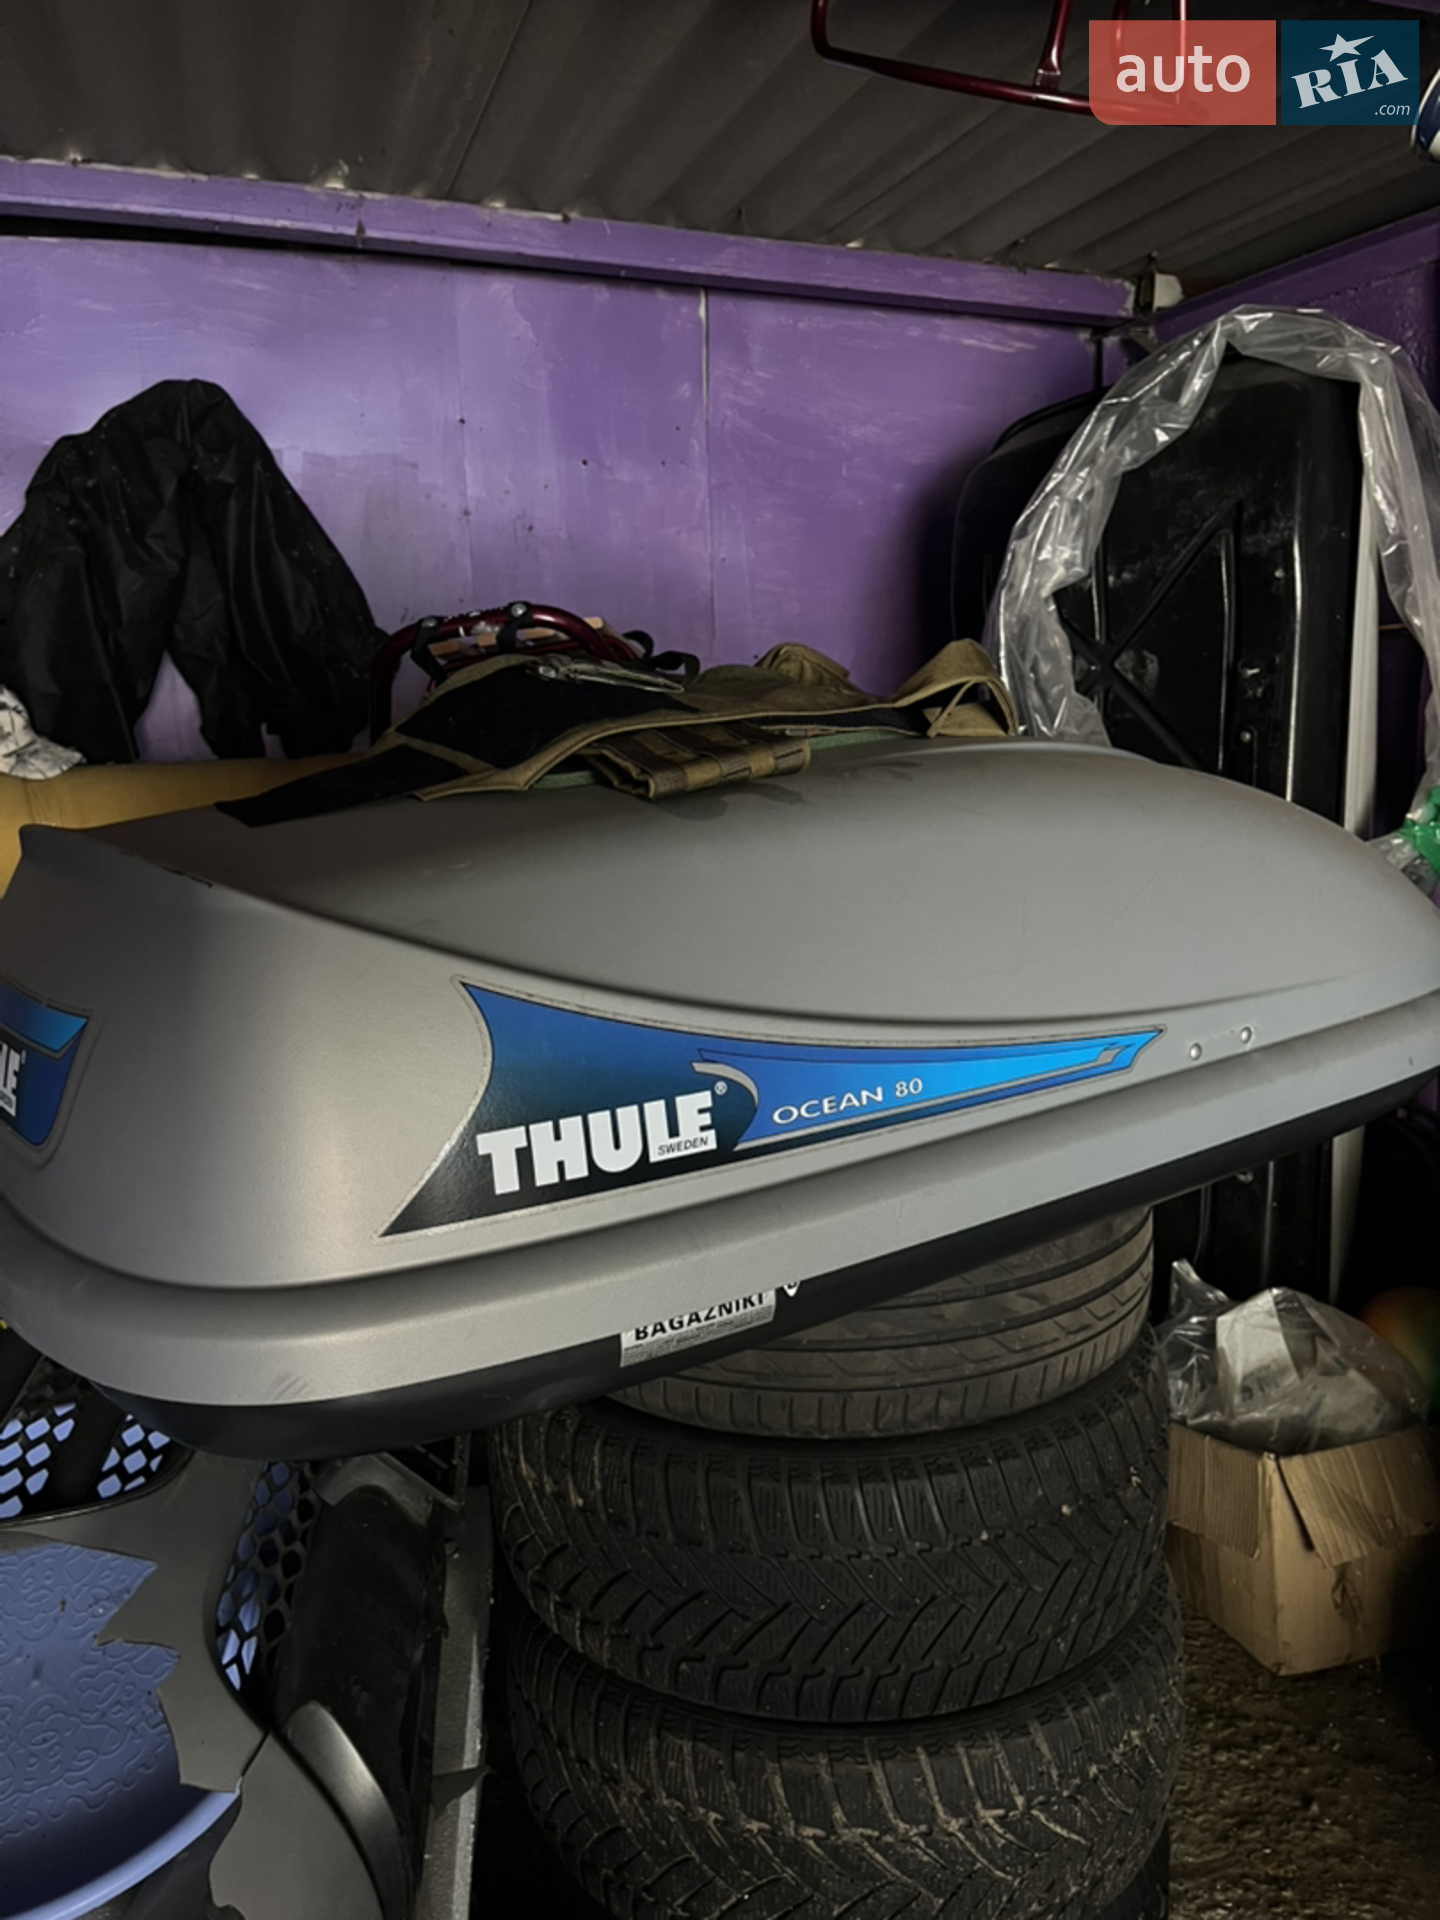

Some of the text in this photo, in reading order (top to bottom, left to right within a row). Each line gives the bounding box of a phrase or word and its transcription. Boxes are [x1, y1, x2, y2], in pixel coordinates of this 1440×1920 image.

[772, 1077, 923, 1124] OCEAN 80
[476, 1090, 718, 1195] THULE
[657, 1135, 709, 1156] SWEDEN
